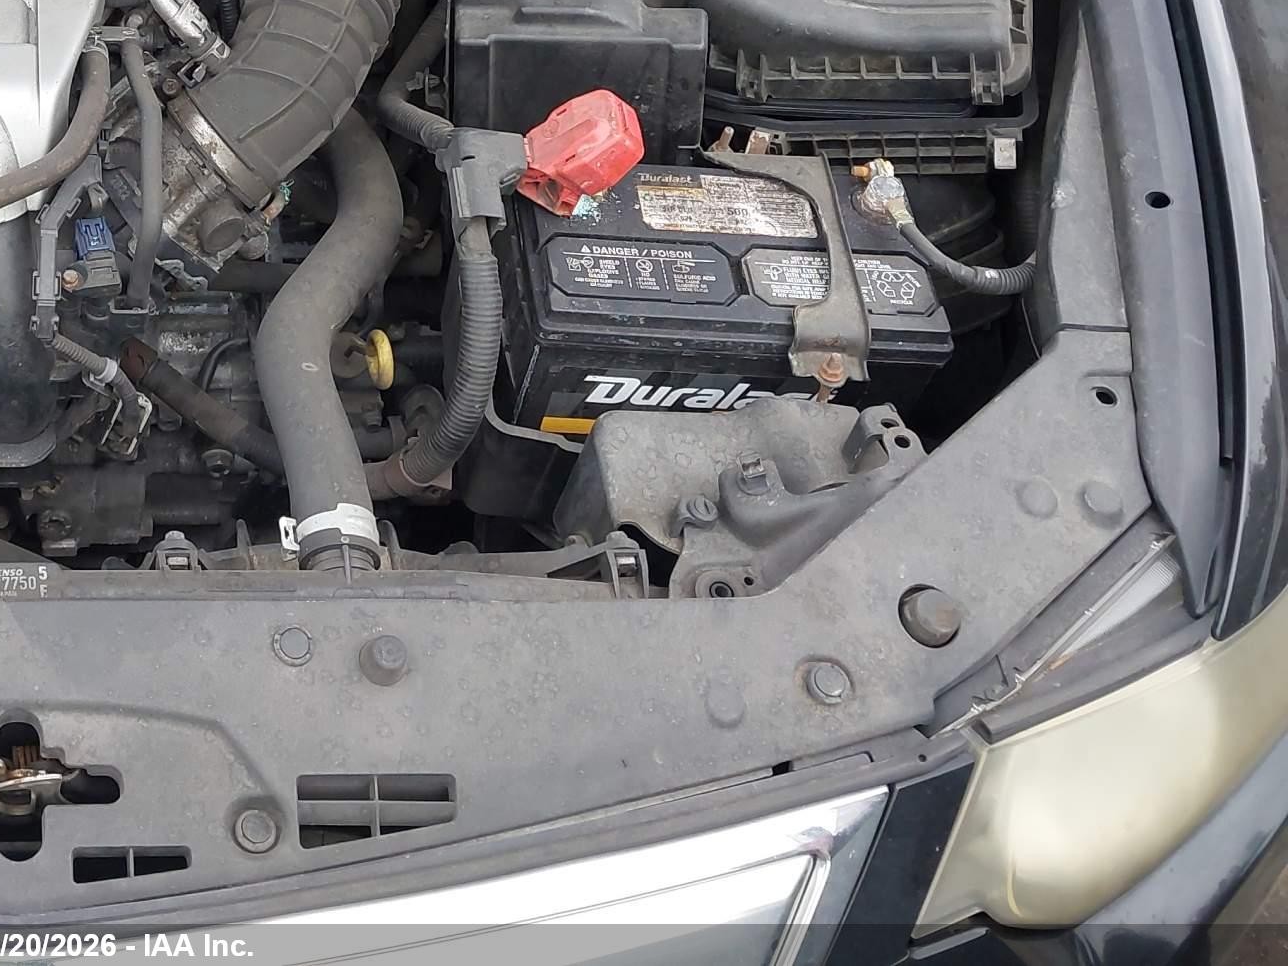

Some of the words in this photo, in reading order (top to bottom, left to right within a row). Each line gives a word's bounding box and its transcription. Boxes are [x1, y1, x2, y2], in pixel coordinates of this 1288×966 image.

[637, 172, 693, 184] Duralast
[593, 245, 639, 256] DANGER
[651, 249, 693, 259] POISON
[584, 375, 838, 410] Durala
[38, 566, 48, 580] 5
